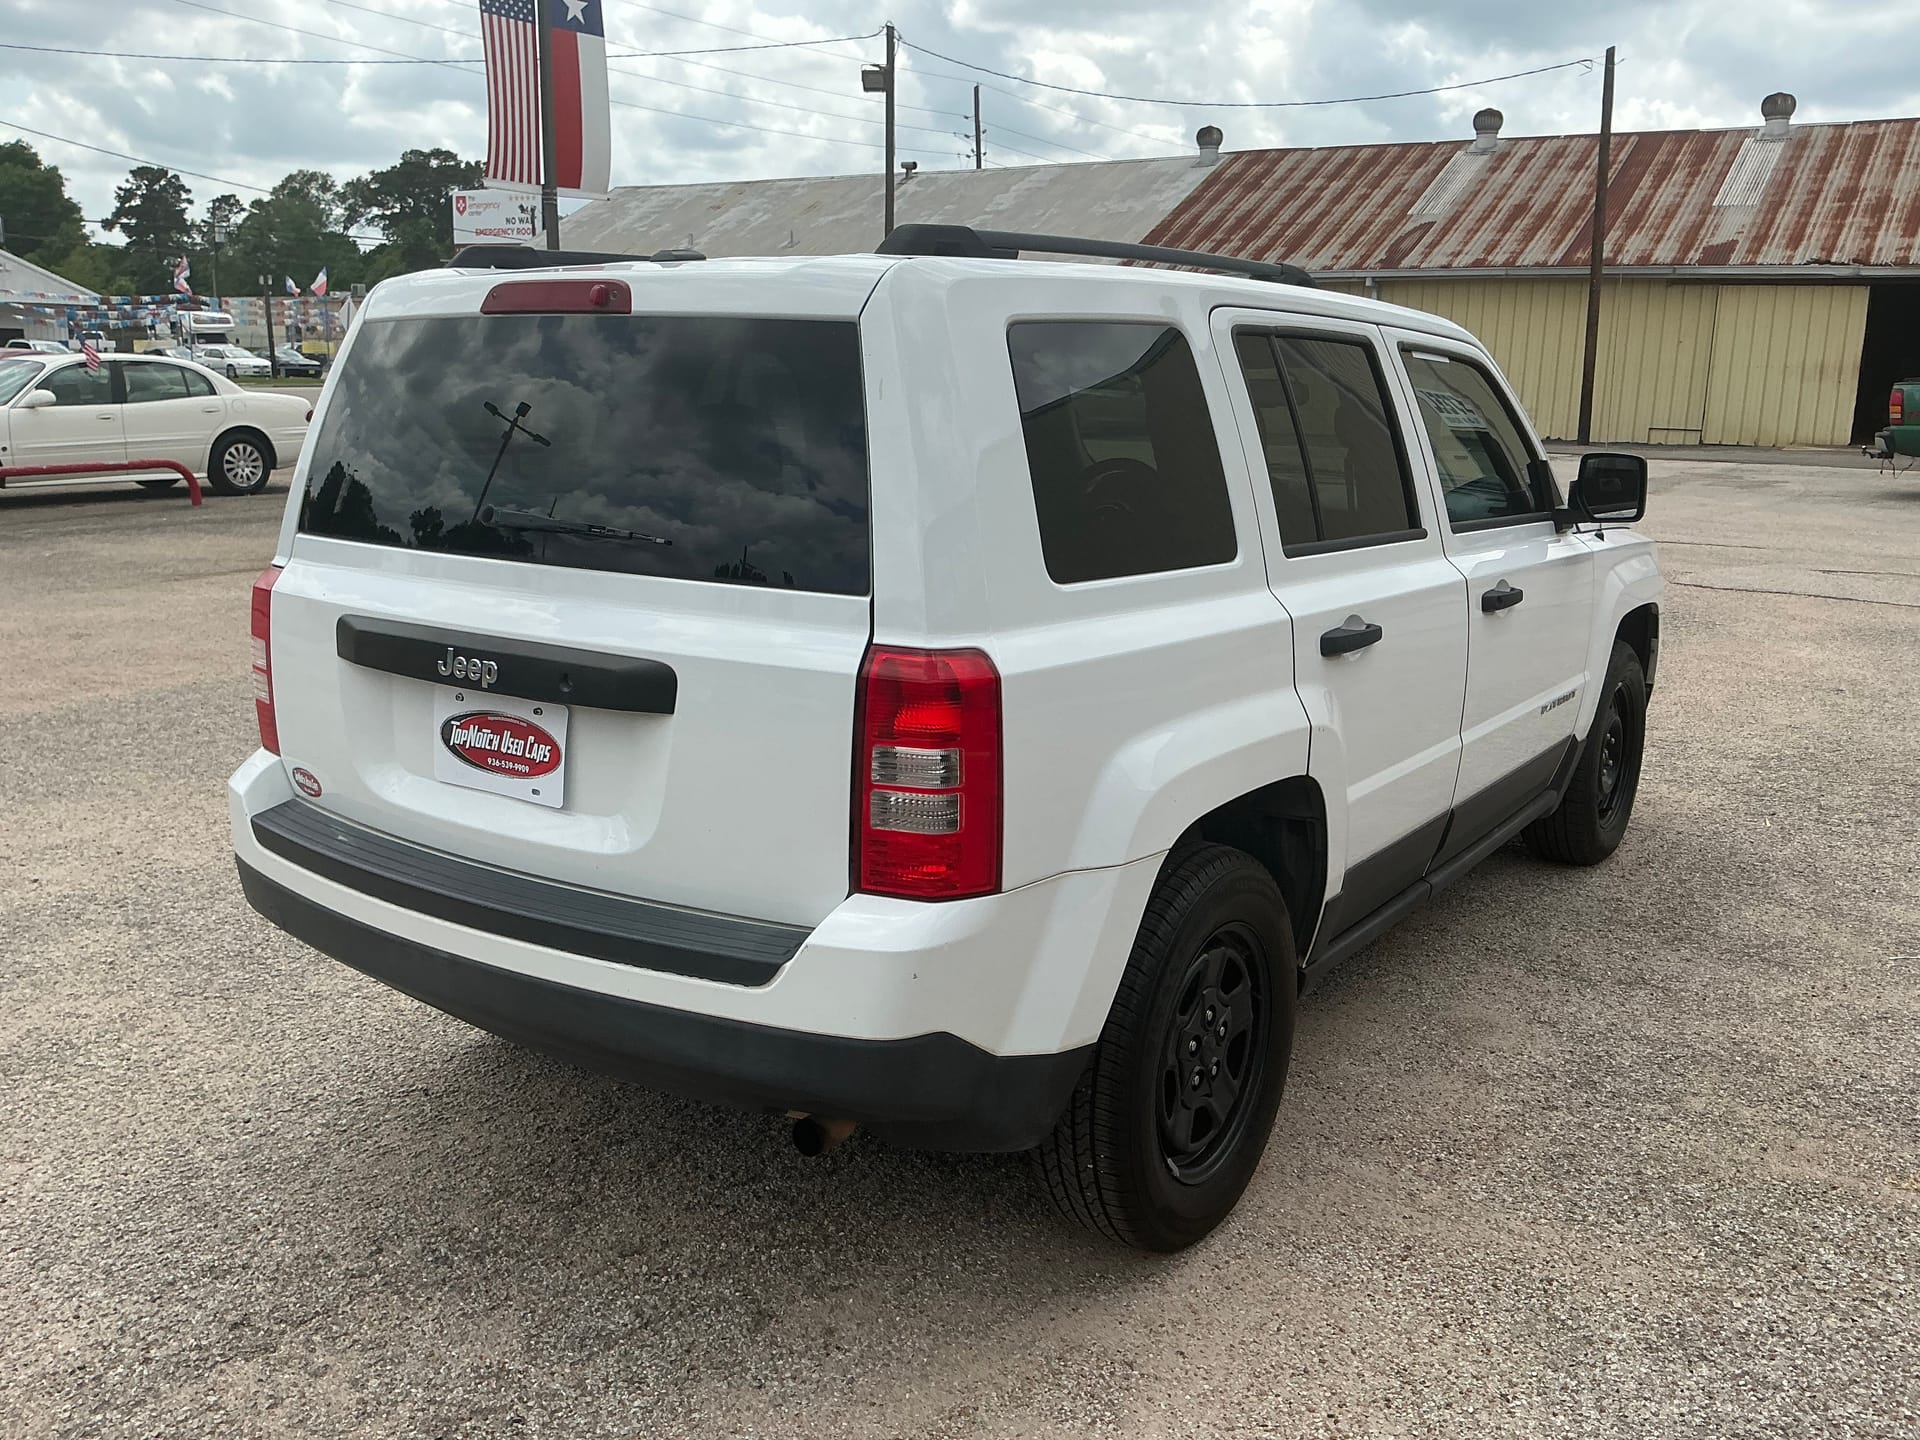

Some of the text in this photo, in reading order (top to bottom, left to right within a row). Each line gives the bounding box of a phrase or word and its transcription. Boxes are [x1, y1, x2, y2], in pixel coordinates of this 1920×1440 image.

[505, 217, 517, 225] NO
[475, 227, 532, 236] EMERGENCY ROO
[437, 647, 498, 688] Jeep
[487, 757, 530, 774] 936-539-9909
